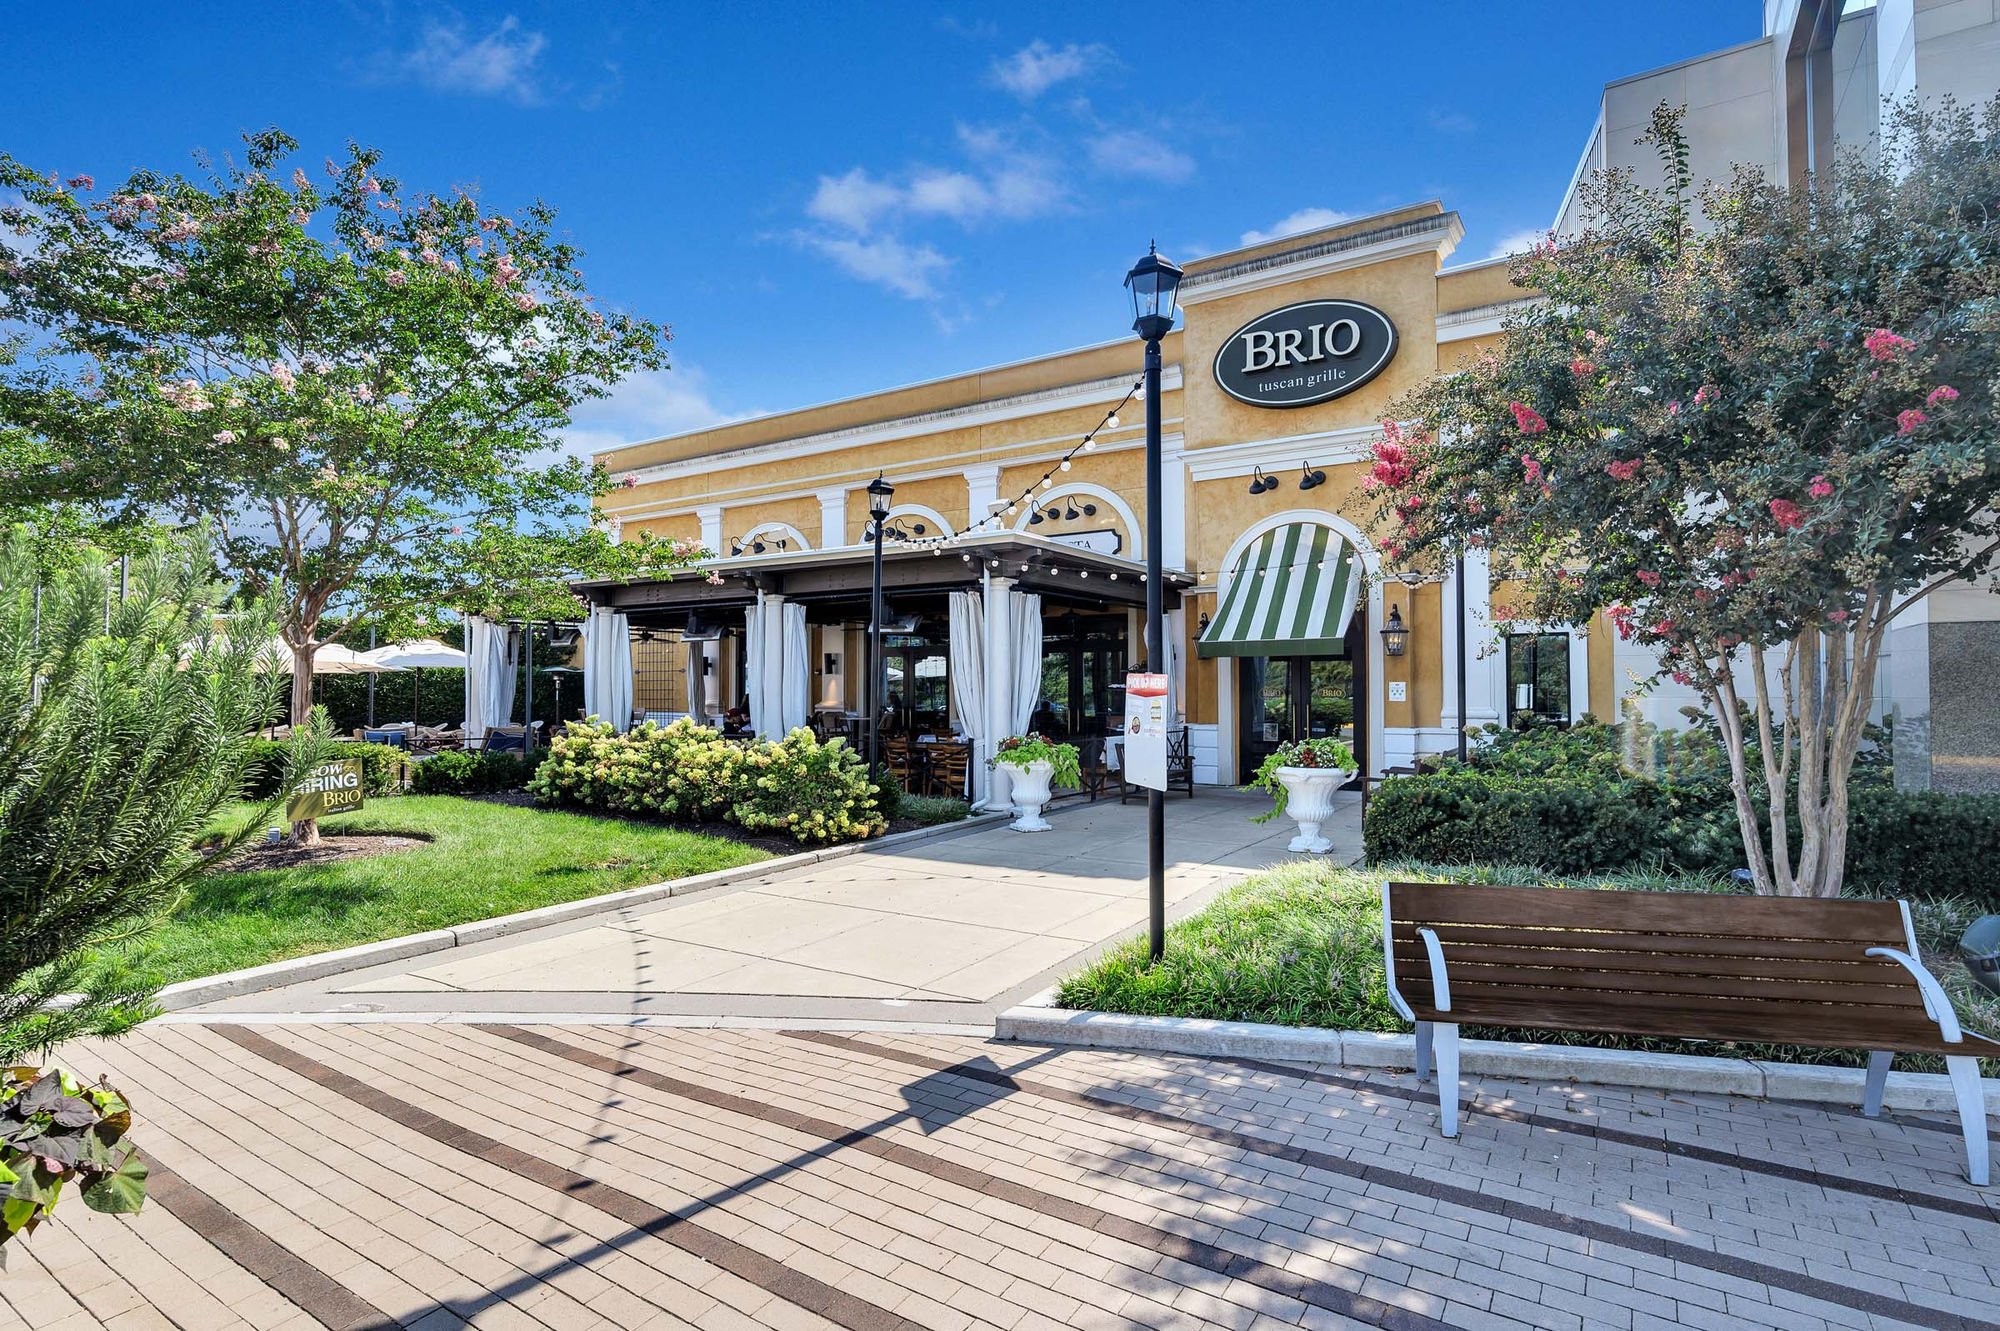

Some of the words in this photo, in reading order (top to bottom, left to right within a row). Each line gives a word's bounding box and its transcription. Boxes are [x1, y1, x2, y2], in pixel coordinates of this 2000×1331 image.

[1241, 318, 1361, 373] BRIO
[1259, 376, 1304, 392] tuscan
[1307, 368, 1347, 388] grille
[1127, 678, 1140, 689] PICK
[1141, 678, 1150, 689] UP
[1151, 678, 1166, 690] HERE
[1322, 689, 1342, 697] BRIO
[323, 789, 361, 807] BRIO
